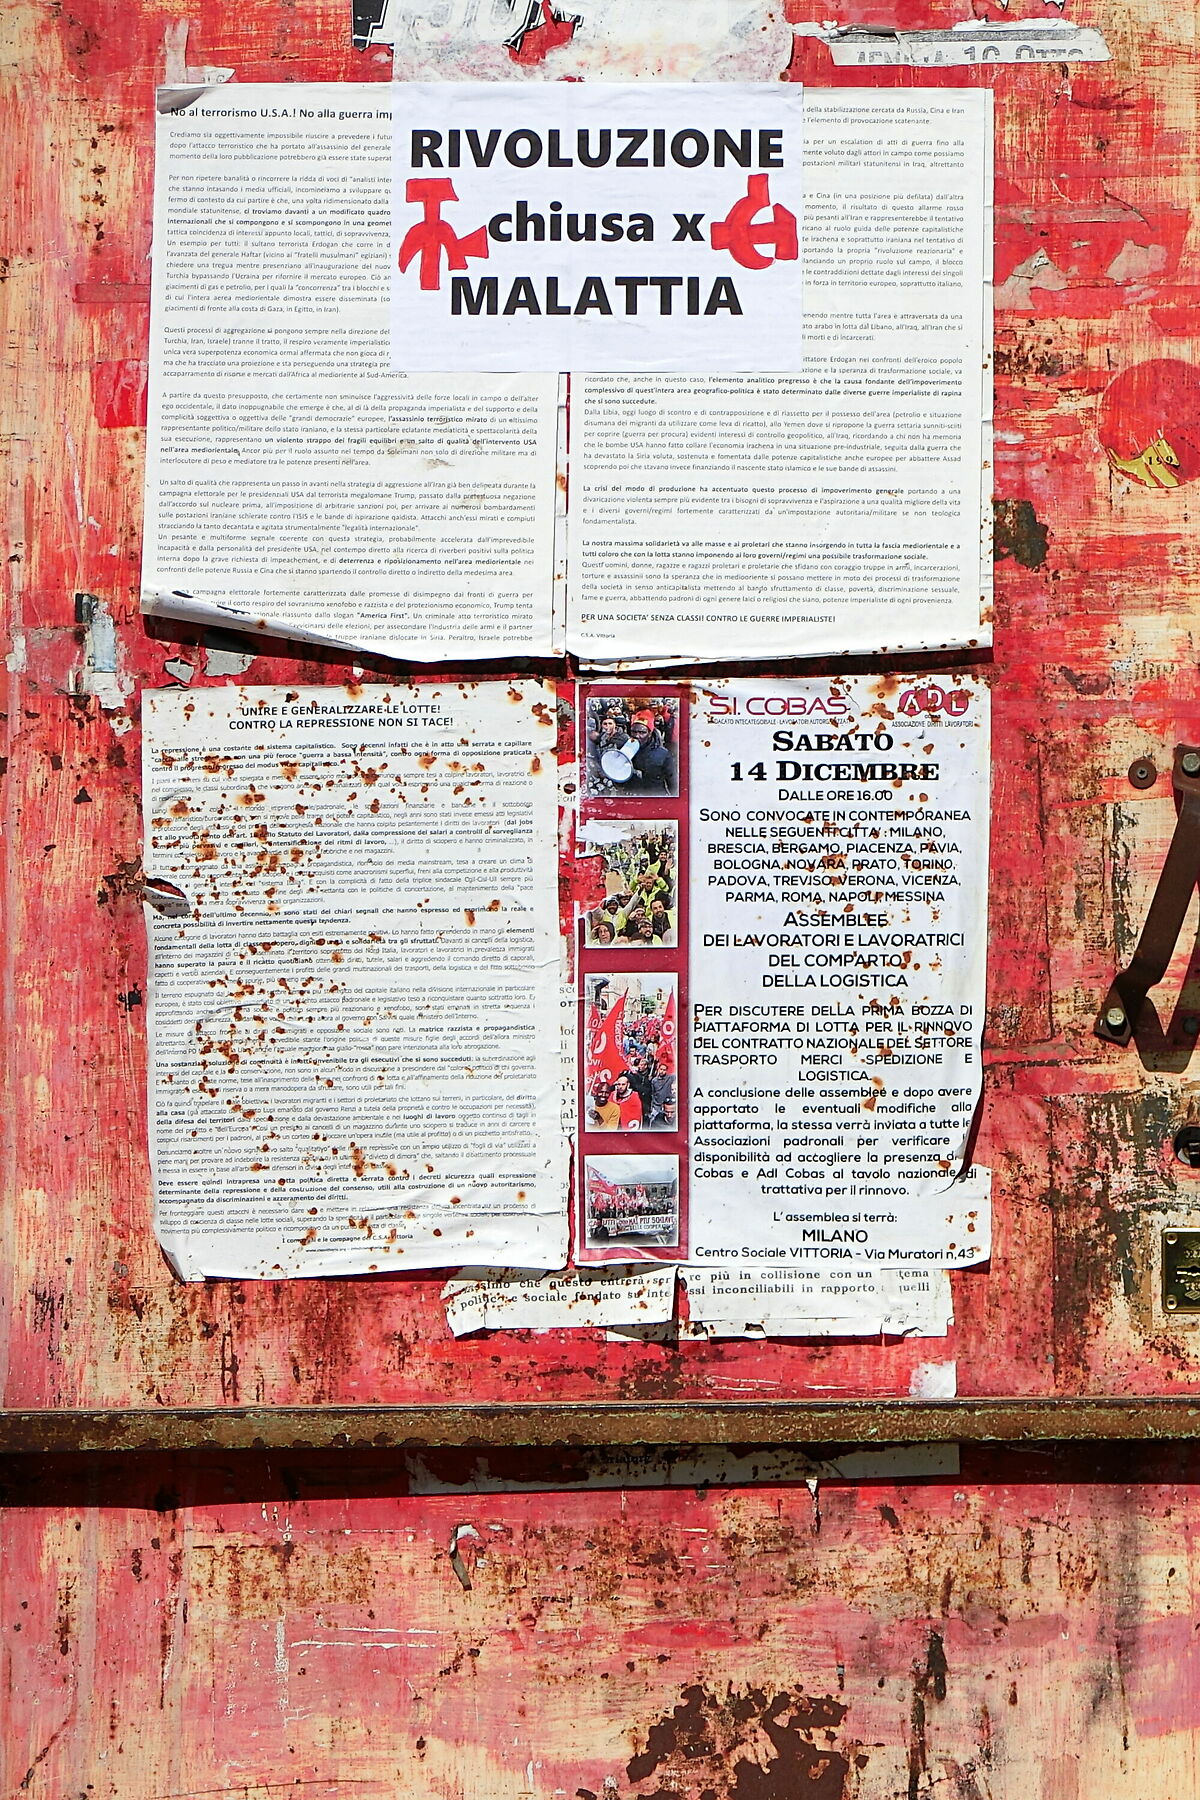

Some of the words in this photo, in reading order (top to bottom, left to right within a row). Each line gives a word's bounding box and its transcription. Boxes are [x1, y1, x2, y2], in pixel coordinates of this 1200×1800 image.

[170, 107, 186, 118] No
[188, 108, 198, 118] al
[201, 108, 257, 118] terrorismo
[260, 108, 296, 118] U.S.A.!
[299, 108, 315, 119] No
[317, 108, 336, 119] alla
[338, 110, 373, 121] guerra
[410, 128, 785, 168] RIVOLUZIONE
[487, 200, 654, 242] chiusa
[671, 213, 706, 241] x
[450, 275, 744, 316] MALATTIA
[581, 613, 596, 622] PER
[597, 613, 615, 622] UNA
[616, 613, 649, 622] SOCIETA'
[650, 614, 675, 622] SENZA
[706, 615, 738, 623] CONTRO
[739, 615, 748, 623] LE
[749, 615, 780, 623] GUERRE
[781, 615, 836, 624] IMPERIALISTE!
[241, 706, 278, 716] UNIRE
[281, 706, 288, 716] E
[290, 705, 384, 716] GENERALIZZARE
[386, 705, 399, 715] LE
[402, 704, 441, 714] LOTTE!
[746, 696, 848, 716] COBAS
[228, 719, 276, 730] CONTRO
[279, 719, 293, 729] LA
[296, 717, 375, 728] REPRESSIONE
[378, 717, 403, 727] NON
[406, 717, 419, 727] SI
[422, 716, 453, 727] TACE!
[773, 730, 893, 752] SABATO
[731, 762, 767, 781] 14
[776, 760, 939, 782] DICEMBRE
[779, 789, 823, 801] DALLE
[827, 791, 854, 801] ORE
[857, 790, 892, 801] 16.00
[700, 808, 740, 822] SONO
[747, 811, 829, 822] CONVOCATE
[833, 811, 845, 822] IN
[849, 810, 971, 822] CONTEMPORANEA
[726, 827, 767, 838] NELLE
[770, 827, 837, 838] SEGUENTI
[890, 827, 945, 839] MILANO,
[708, 843, 768, 855] BRESCIA,
[772, 843, 843, 856] BERGAMO,
[846, 843, 917, 855] PIACENZA,
[920, 843, 962, 854] PAVIA,
[714, 859, 783, 871] BOLOGNA,
[786, 859, 849, 870] NOVARA,
[852, 859, 900, 871] PRATO,
[904, 859, 956, 871] TORINO,
[709, 875, 769, 887] PADOVA,
[839, 875, 898, 887] VERONA,
[902, 875, 961, 887] VICENZA,
[726, 892, 778, 903] PARMA,
[782, 892, 825, 904] ROMA,
[885, 892, 944, 903] MESSINA
[784, 912, 888, 927] ASSEMBLEE
[704, 933, 729, 946] DEI
[734, 933, 839, 947] LAVORATORI
[845, 933, 854, 946] E
[859, 932, 964, 947] LAVORATRICI
[769, 954, 800, 967] DEL
[804, 954, 903, 968] COMPARTO
[763, 974, 816, 987] DELLA
[821, 973, 908, 987] LOGISTICA
[694, 1004, 722, 1017] PER
[730, 1006, 804, 1017] DISCUTERE
[812, 1005, 855, 1017] DELLA
[862, 1005, 904, 1016] PRIMA
[912, 1005, 954, 1016] BOZZA
[960, 1005, 972, 1016] DI
[694, 1021, 790, 1032] PIATTAFORMA
[797, 1021, 809, 1032] DI
[816, 1021, 859, 1032] LOTTA
[866, 1021, 893, 1032] PER
[915, 1021, 972, 1032] RINNOVO
[694, 1037, 719, 1049] DEL
[722, 1038, 803, 1049] CONTRATTO
[807, 1038, 884, 1049] NAZIONALE
[887, 1038, 911, 1049] DEL
[915, 1037, 972, 1049] SETTORE
[694, 1054, 777, 1065] TRASPORTO
[801, 1054, 842, 1065] MERCI
[866, 1053, 943, 1065] SPEDIZIONE
[965, 1053, 972, 1063] E
[786, 1212, 849, 1222] assemblea
[852, 1212, 860, 1222] si
[864, 1211, 897, 1222] terrà:
[803, 1228, 868, 1243] MILANO
[696, 1247, 738, 1258] Centro
[742, 1247, 786, 1257] Sociale
[790, 1247, 852, 1259] VITTORIA
[865, 1249, 885, 1260] Via
[889, 1248, 942, 1259] Muratori
[688, 1273, 701, 1281] re
[710, 1271, 730, 1283] più
[739, 1271, 752, 1281] in
[760, 1270, 821, 1280] collisione
[829, 1271, 852, 1279] con
[857, 1271, 873, 1279] un
[688, 1285, 706, 1295] ssi
[712, 1284, 795, 1295] inconciliabili
[801, 1284, 813, 1293] in
[820, 1284, 875, 1295] rapporto
